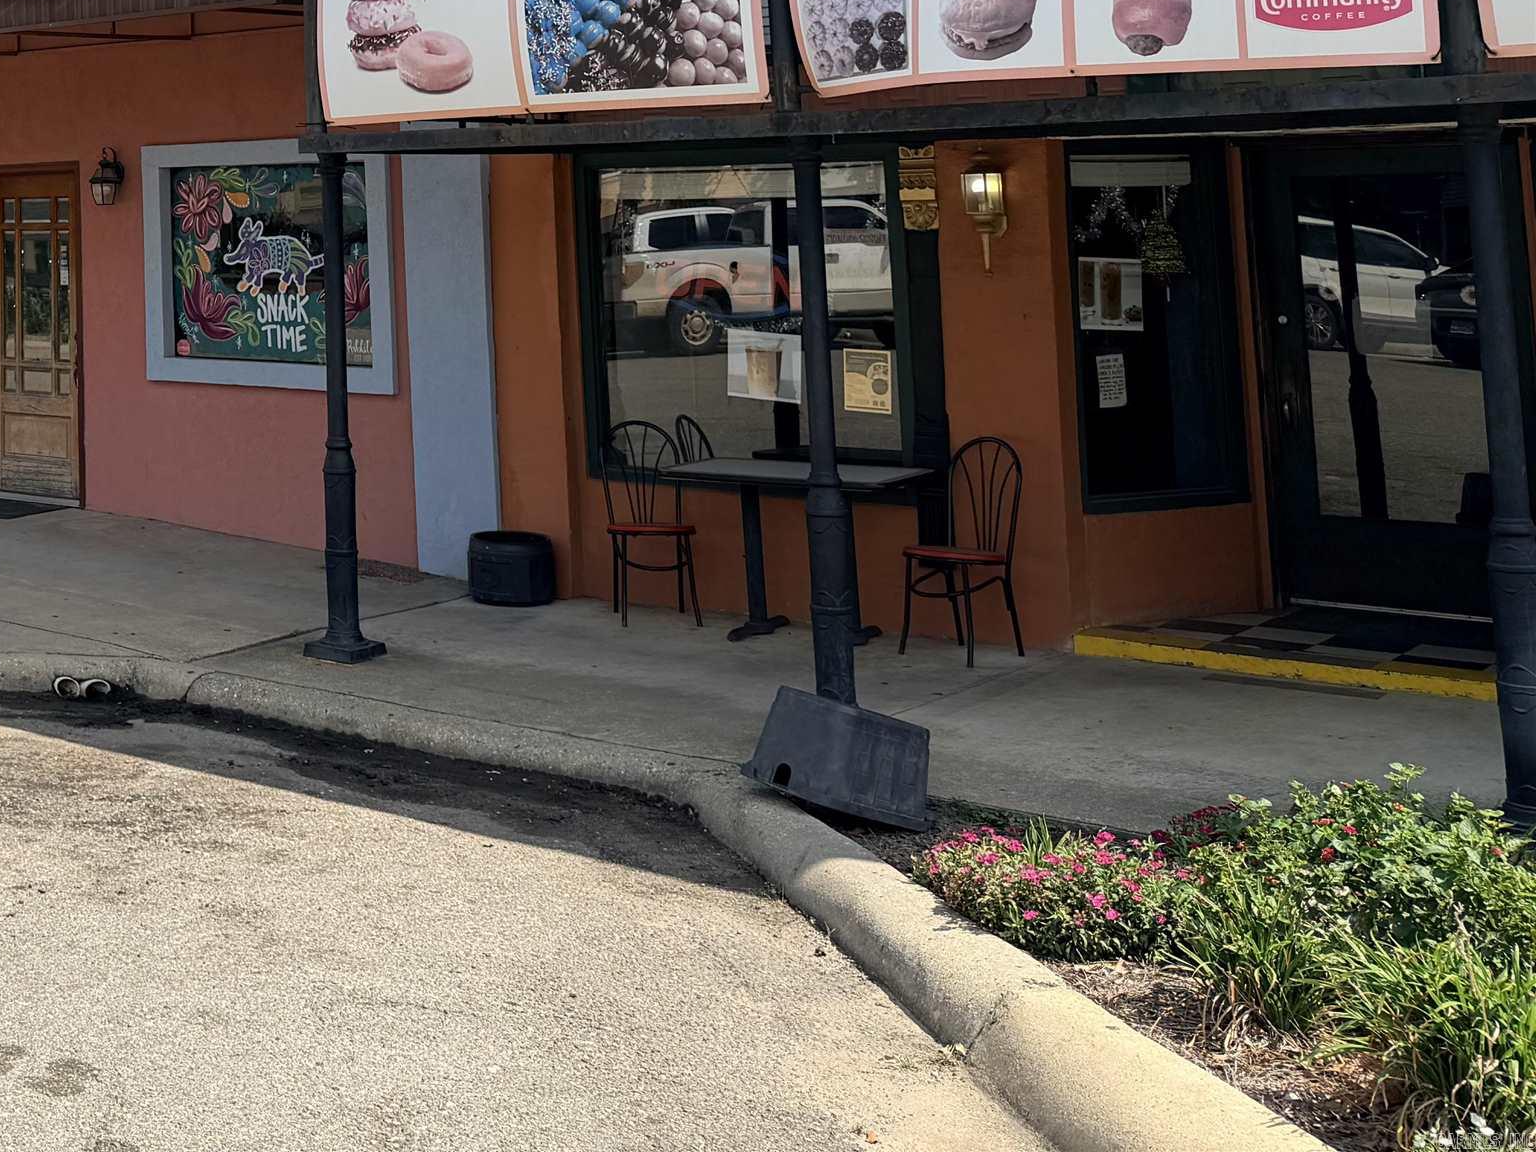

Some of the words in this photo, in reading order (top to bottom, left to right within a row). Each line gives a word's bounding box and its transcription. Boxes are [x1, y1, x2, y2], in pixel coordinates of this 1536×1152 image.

[1300, 11, 1367, 22] COFFEE
[256, 293, 311, 325] SNACK
[261, 324, 308, 353] TIME
